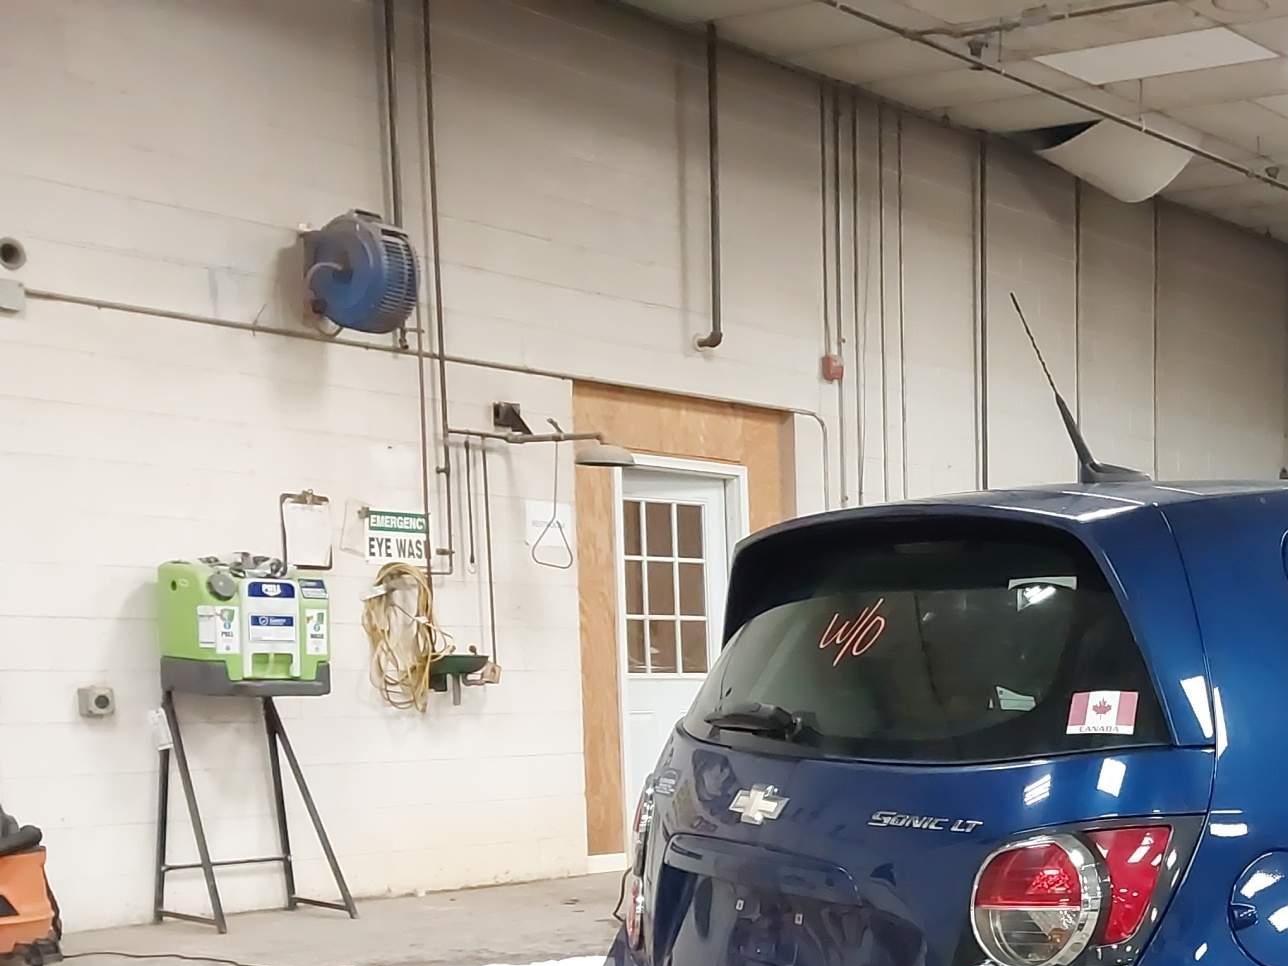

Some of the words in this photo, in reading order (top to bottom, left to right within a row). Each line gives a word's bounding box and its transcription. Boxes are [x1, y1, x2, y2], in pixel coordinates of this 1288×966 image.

[369, 537, 393, 558] EYE
[396, 538, 426, 560] WAS
[1079, 725, 1120, 733] CANADA
[950, 819, 984, 833] LT
